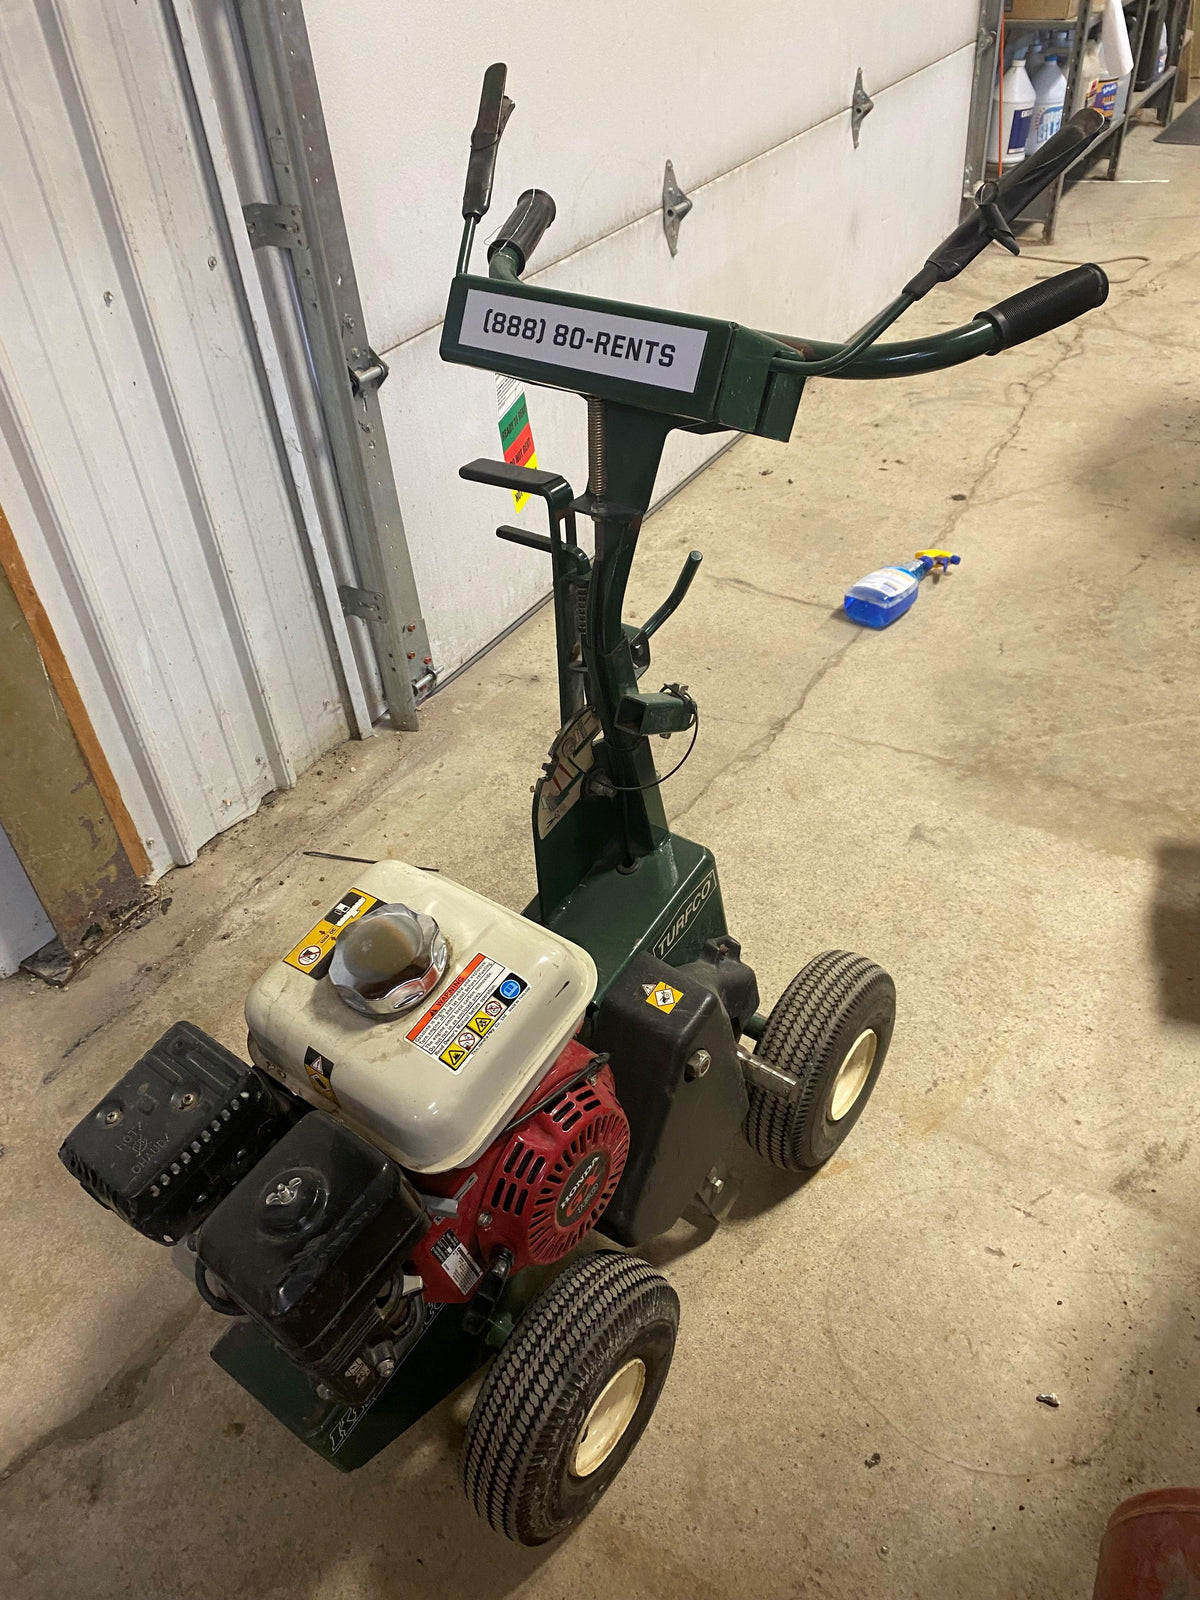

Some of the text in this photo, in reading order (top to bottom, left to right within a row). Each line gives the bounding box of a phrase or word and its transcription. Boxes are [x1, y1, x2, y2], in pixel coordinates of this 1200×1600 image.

[483, 308, 677, 368] (888) 80-RENTS
[658, 878, 711, 957] TURFCO
[414, 1024, 431, 1042] Gasoline
[433, 1007, 446, 1020] highly
[444, 986, 463, 1007] flammable
[462, 978, 470, 986] and
[419, 1035, 428, 1044] Turn
[427, 1021, 441, 1035] engine
[444, 1006, 452, 1014] and
[456, 991, 465, 1000] cool
[464, 978, 476, 991] before
[424, 1040, 433, 1048] The
[431, 1025, 446, 1041] engine
[443, 1014, 455, 1026] emits
[453, 1004, 464, 1014] toxic
[462, 990, 475, 1004] carbon
[434, 1037, 442, 1045] not
[440, 1029, 448, 1038] run
[456, 1001, 472, 1019] enclosed
[471, 990, 482, 1001] area.
[436, 975, 464, 1007] WARNING
[434, 1044, 444, 1055] Read
[443, 1029, 457, 1045] Owner's
[456, 1014, 470, 1029] Manual
[468, 1002, 480, 1015] before
[561, 1157, 600, 1208] HONDA
